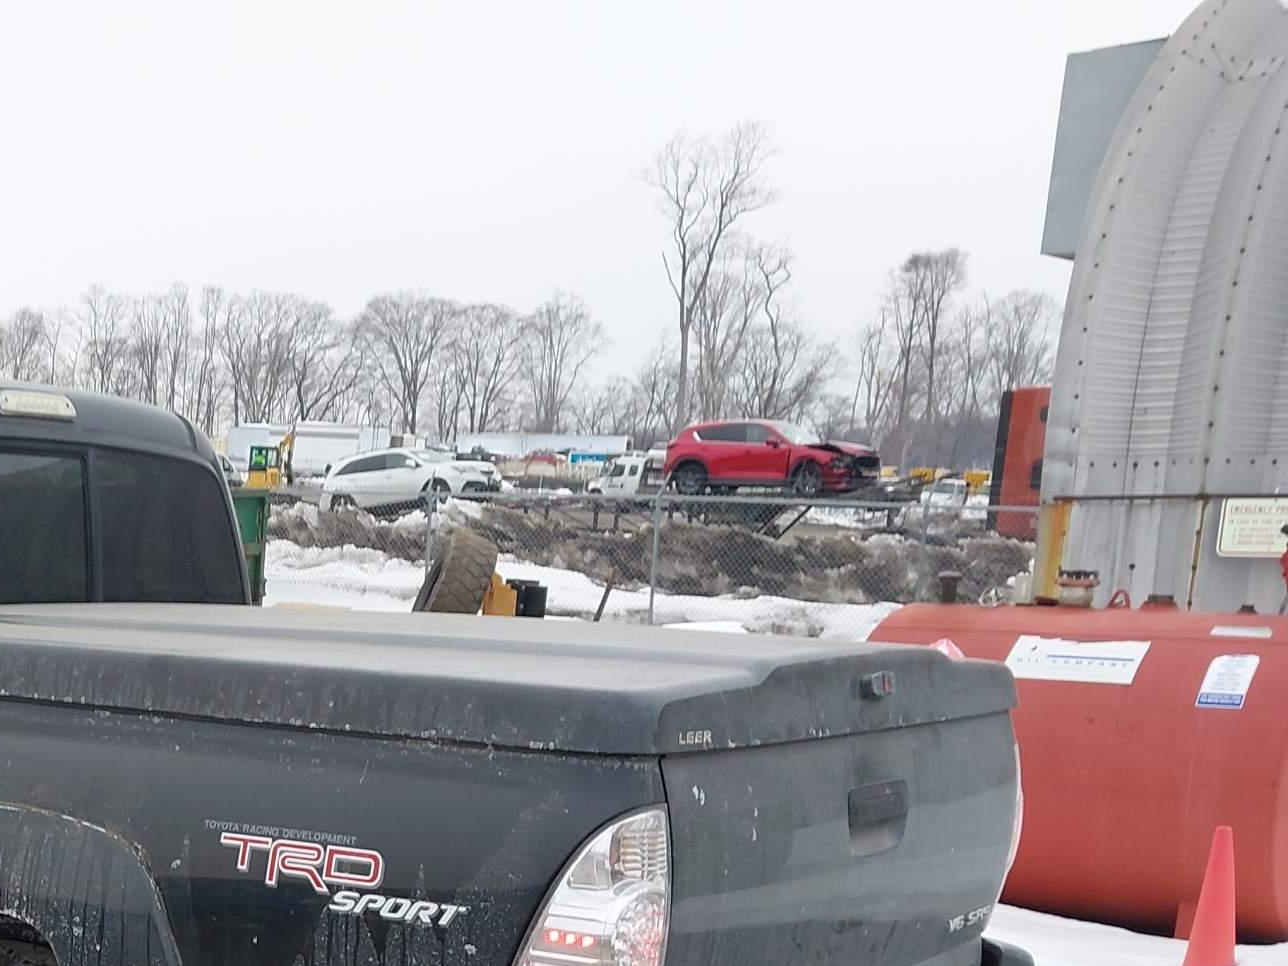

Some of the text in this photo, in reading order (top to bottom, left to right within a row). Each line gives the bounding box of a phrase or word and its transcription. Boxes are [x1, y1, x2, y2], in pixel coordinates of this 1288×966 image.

[678, 730, 712, 745] LEER
[203, 819, 357, 846] TOYOTA RACING DEVELOPMENT
[220, 832, 386, 896] TRD
[328, 890, 470, 927] SPORT
